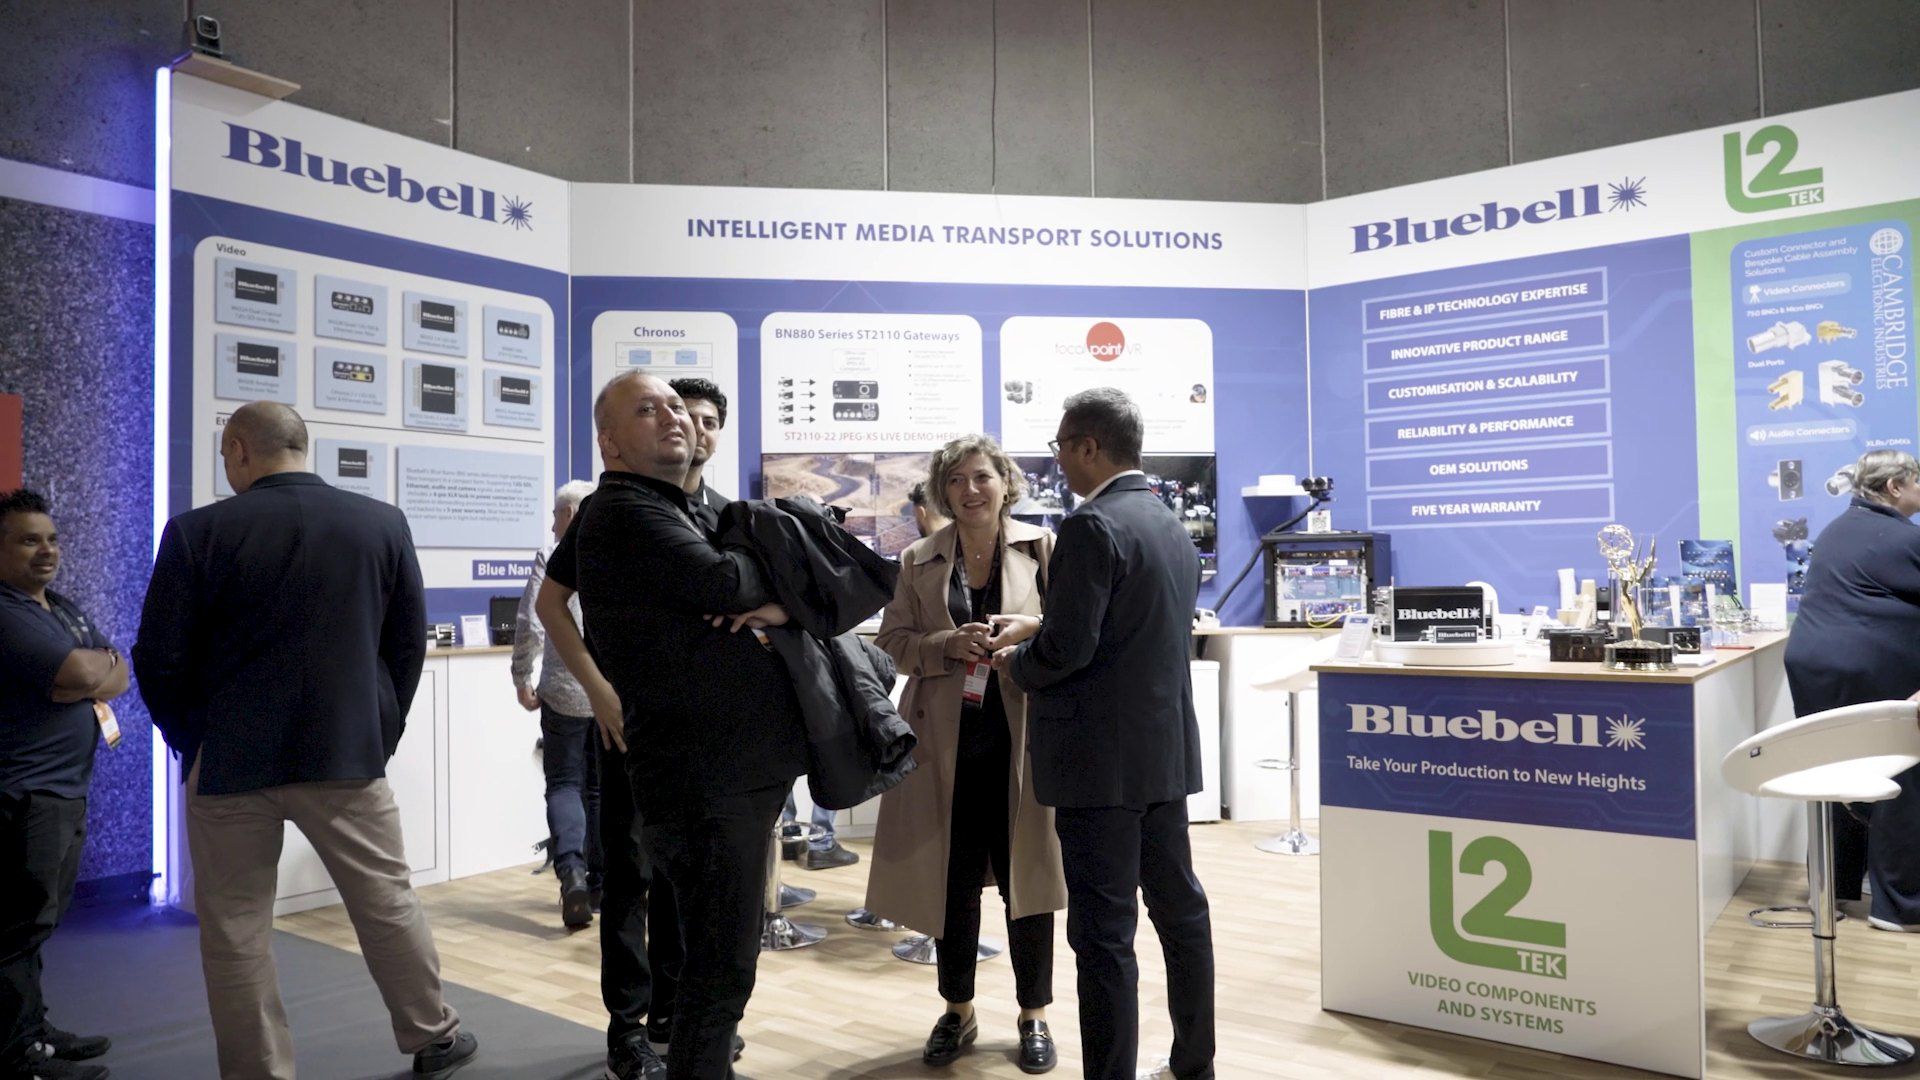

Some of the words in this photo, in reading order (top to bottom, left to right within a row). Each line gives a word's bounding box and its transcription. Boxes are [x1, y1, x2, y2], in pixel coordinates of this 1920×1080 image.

[222, 121, 497, 223] Bluebell
[1788, 187, 1823, 206] TEK
[1350, 184, 1603, 254] Bluebell
[687, 218, 848, 242] INTELLIGENT
[855, 223, 934, 244] MEDIA
[942, 225, 1082, 247] TRANSPORT
[1089, 228, 1223, 250] SOLUTIONS
[216, 243, 246, 256] Video
[1744, 247, 1779, 259] Custom
[1780, 242, 1827, 253] Connector
[1828, 238, 1846, 247] and
[1745, 256, 1783, 268] Bespoke
[1785, 253, 1811, 263] Cable
[1813, 247, 1858, 258] Assembly
[1745, 266, 1786, 277] Solutions
[1764, 286, 1790, 296] Video
[1792, 279, 1846, 293] Connectors
[1871, 257, 1885, 325] ELECTRONIC
[1379, 307, 1411, 320] FIBRE
[1411, 305, 1422, 317] &
[1424, 303, 1435, 315] IP
[1437, 293, 1518, 313] TECHNOLOGY
[1521, 283, 1588, 303] EXPERTISE
[634, 326, 686, 338] Chronos
[1881, 255, 1908, 389] CAMBRIDGE
[775, 328, 815, 340] BN880
[818, 329, 854, 340] Series
[857, 329, 900, 341] ST2110
[904, 330, 960, 343] Gateways
[1391, 342, 1462, 360] INNOVATIVE
[1463, 335, 1523, 353] PRODUCT
[1524, 330, 1568, 347] RANGE
[1748, 360, 1765, 368] Dual
[1874, 327, 1888, 390] INDUSTRIES
[1388, 379, 1484, 398] CUSTOMISATION
[1486, 378, 1496, 390] &
[1497, 370, 1578, 389] SCALABILITY
[784, 431, 836, 441] ST2110-22
[839, 431, 878, 442] JPEG-XS
[880, 431, 901, 441] LIVE
[904, 432, 935, 442] DEMO
[1398, 423, 1465, 439] RELIABILITY
[1468, 422, 1478, 434] &
[1479, 415, 1574, 435] PERFORMANCE
[1768, 429, 1794, 439] Audio
[1796, 425, 1850, 437] Connectors
[1429, 463, 1456, 476] OEM
[1457, 458, 1528, 475] SOLUTIONS
[1412, 504, 1438, 516] FIVE
[1438, 503, 1470, 515] YEAR
[1471, 500, 1541, 514] WARRANTY
[478, 563, 505, 576] Blue
[508, 563, 532, 576] Nan
[1398, 608, 1469, 620] Bluebell
[1347, 703, 1602, 747] Bluebell
[1347, 755, 1380, 771] Take
[1384, 757, 1417, 774] Your
[1420, 760, 1509, 782] Production
[1513, 767, 1530, 782] to
[1534, 768, 1573, 785] New
[1577, 770, 1646, 792] Heights
[1517, 951, 1564, 975] TEK
[1407, 971, 1462, 993] VIDEO
[1466, 980, 1597, 1017] COMPONENTS
[1437, 999, 1476, 1018] AND
[1480, 1002, 1564, 1034] SYSTEMS
